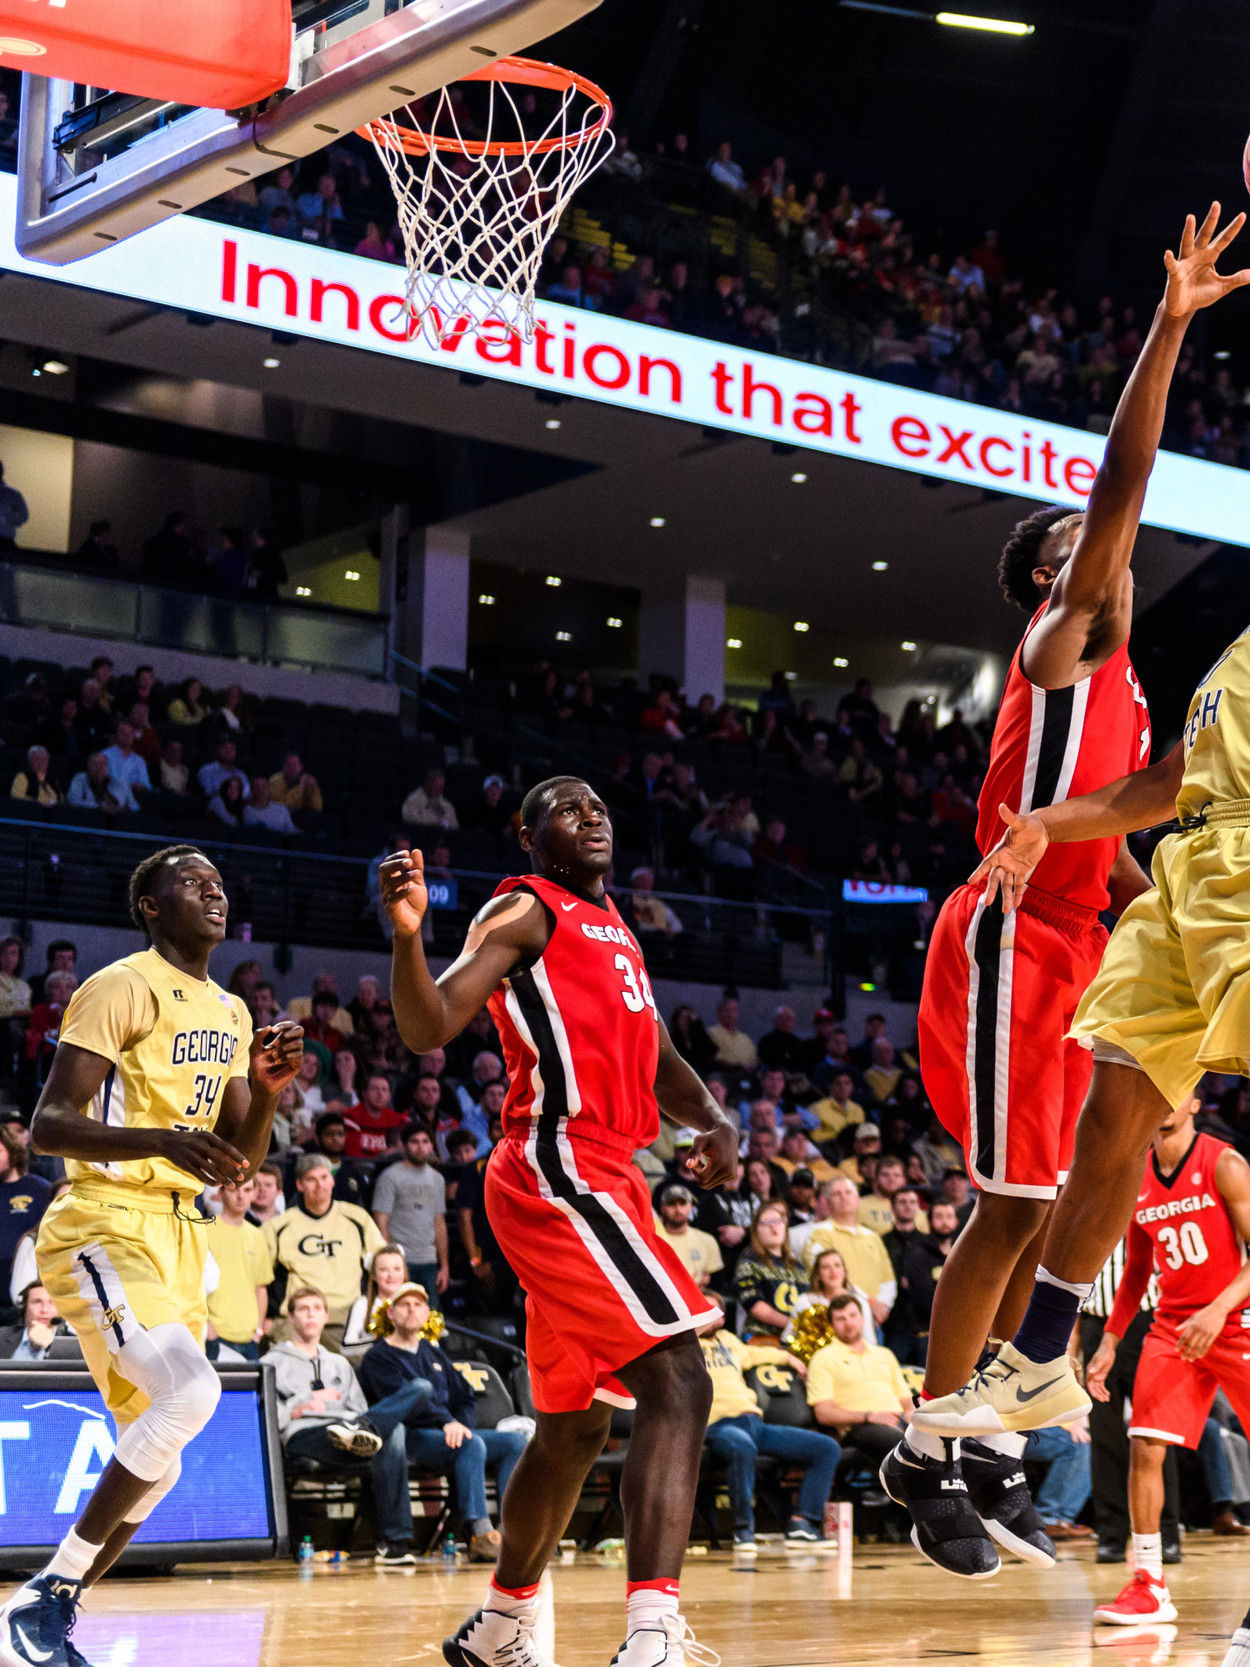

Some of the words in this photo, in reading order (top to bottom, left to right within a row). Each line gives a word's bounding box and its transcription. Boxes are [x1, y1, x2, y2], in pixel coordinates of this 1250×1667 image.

[221, 238, 682, 405] Innovation
[710, 361, 862, 444] that
[891, 415, 1098, 497] excite
[614, 952, 658, 1022] 34
[184, 1073, 222, 1117] 34
[1135, 1192, 1217, 1225] GEORGIA
[1157, 1220, 1210, 1271] 30
